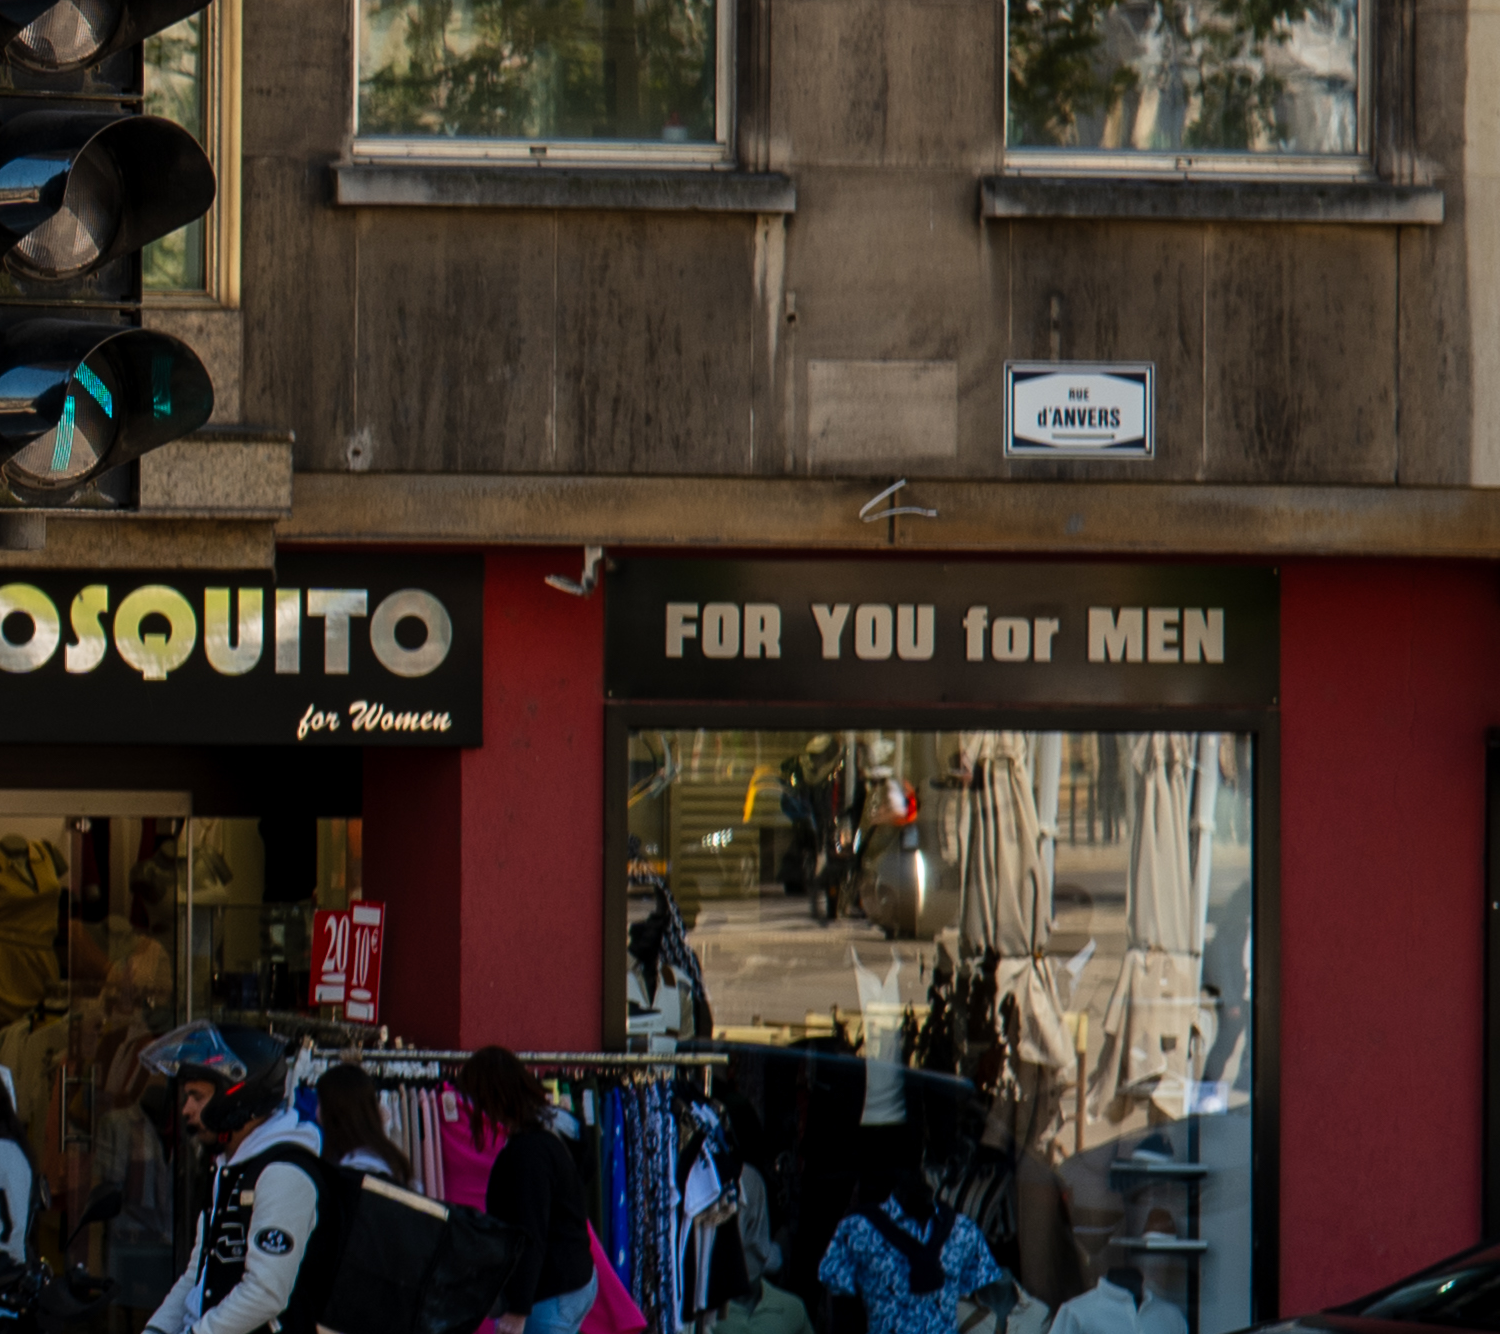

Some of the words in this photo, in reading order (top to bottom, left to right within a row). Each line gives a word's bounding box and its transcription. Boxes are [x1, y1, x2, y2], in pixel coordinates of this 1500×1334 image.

[1036, 404, 1121, 432] d'ANVERS
[1068, 386, 1090, 402] RUE
[664, 601, 782, 661] FOR
[811, 602, 935, 662] YOU
[963, 603, 1060, 663] for
[1088, 606, 1226, 665] MEN
[297, 703, 339, 741] for
[349, 699, 453, 733] Women
[321, 914, 351, 974] 20
[351, 926, 379, 988] 10€
